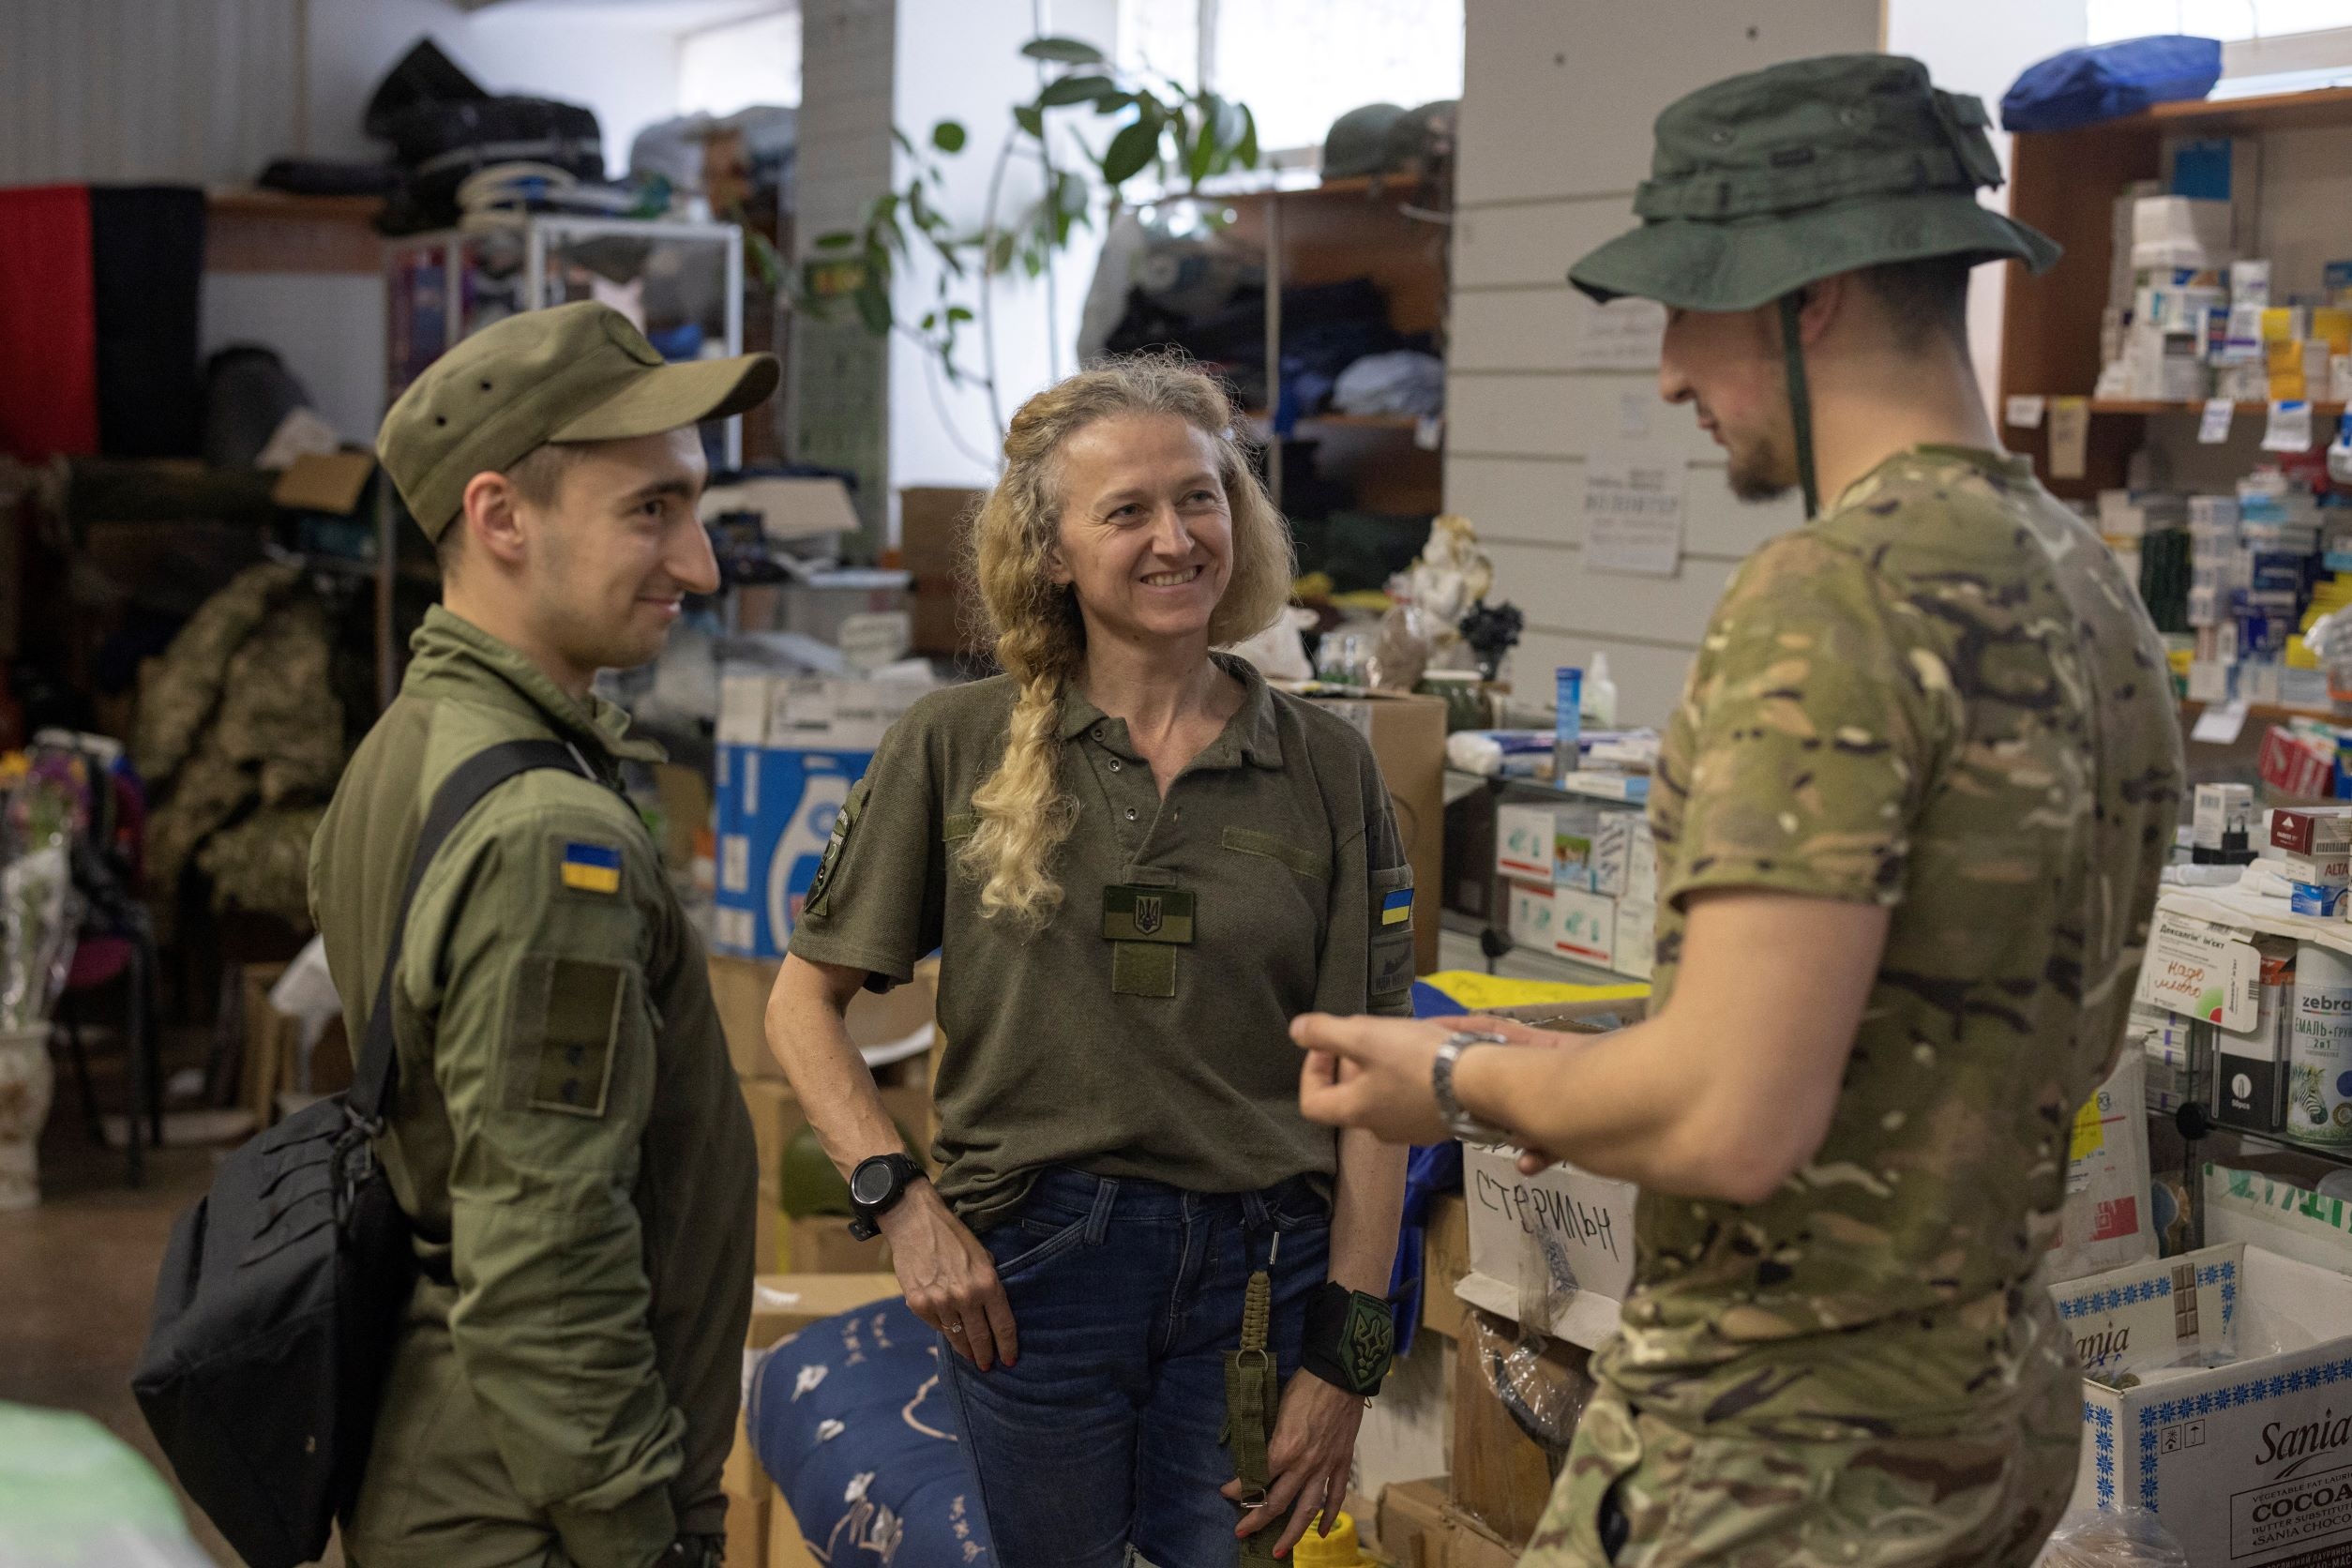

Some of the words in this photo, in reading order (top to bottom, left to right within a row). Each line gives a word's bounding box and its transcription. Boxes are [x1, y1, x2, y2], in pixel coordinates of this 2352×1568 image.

[2302, 995, 2352, 1011] zebra
[2075, 1320, 2130, 1360] ania
[2254, 1407, 2352, 1466] Sania
[2252, 1483, 2352, 1522] COCOA
[2253, 1485, 2304, 1502] VEGETABLE
[2307, 1479, 2323, 1489] FAT
[2325, 1471, 2352, 1485] LAURI
[2252, 1518, 2292, 1534] BUTTER
